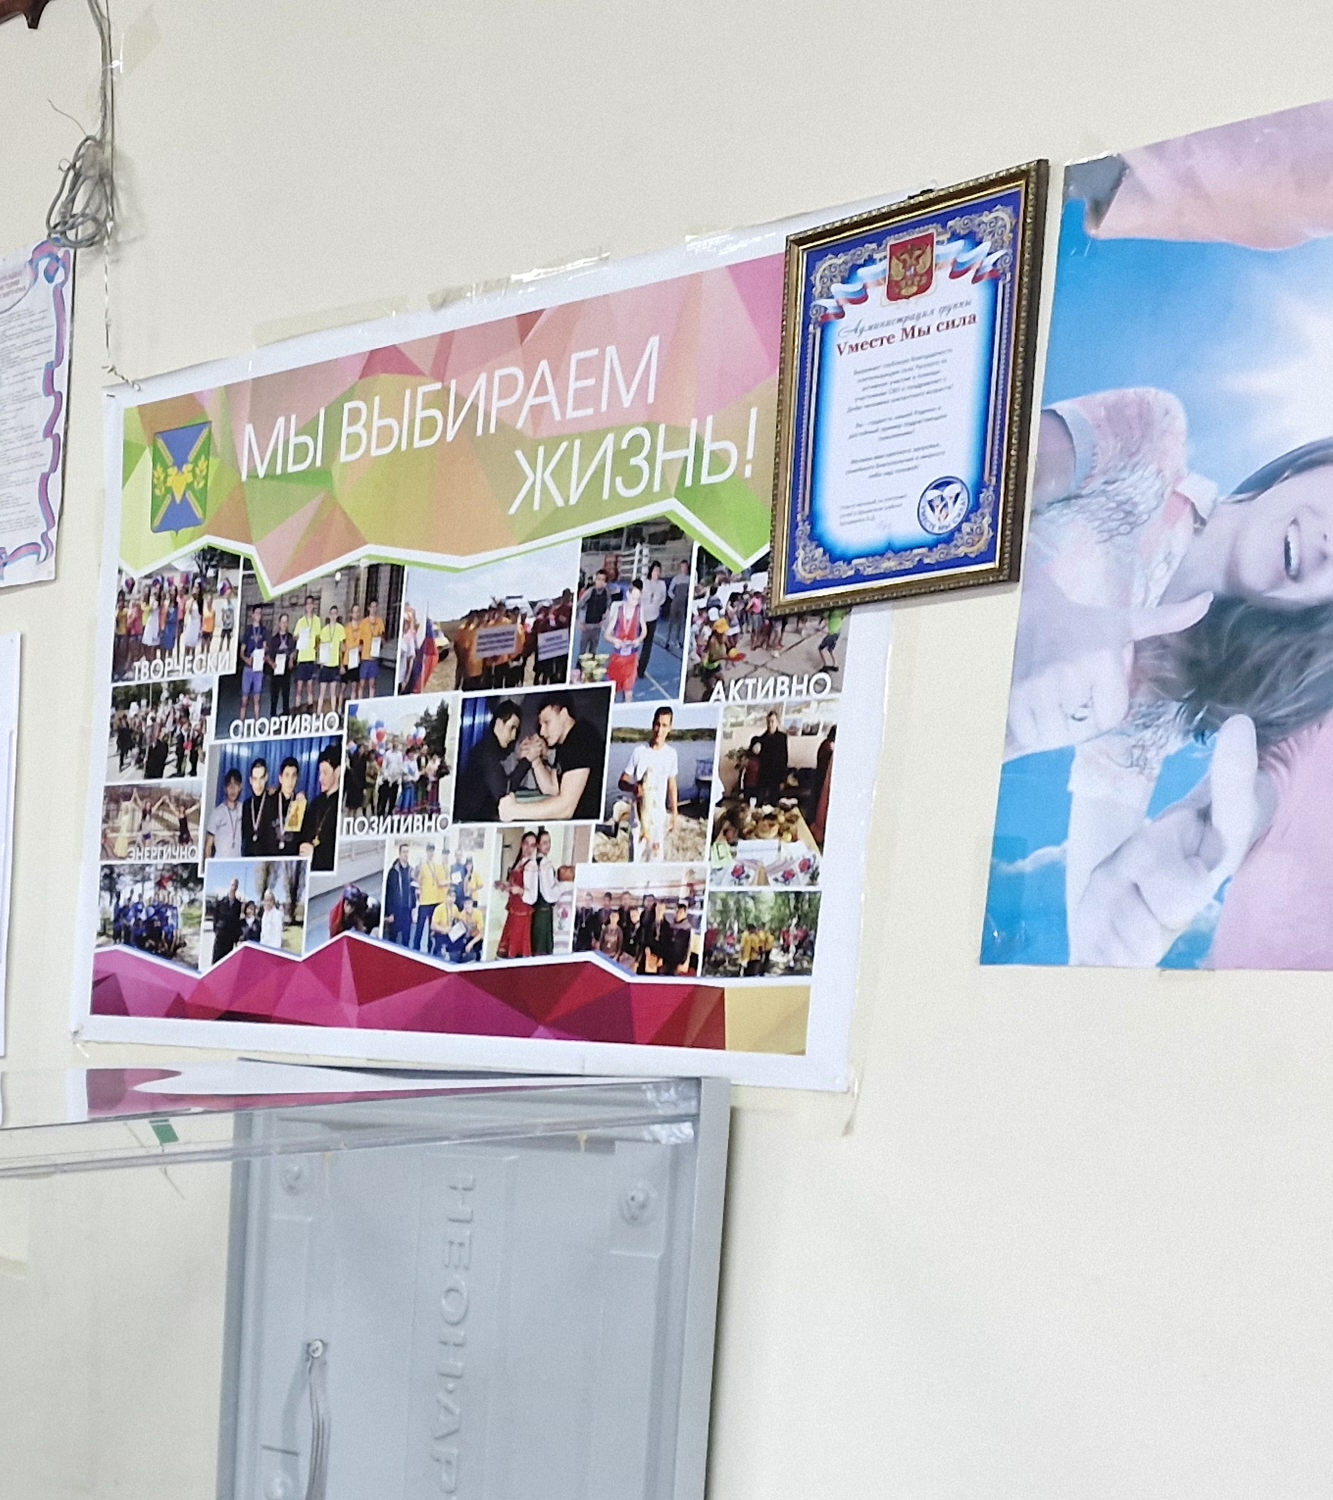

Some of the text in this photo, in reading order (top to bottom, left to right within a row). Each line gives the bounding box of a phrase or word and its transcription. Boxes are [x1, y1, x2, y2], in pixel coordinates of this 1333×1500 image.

[900, 324, 931, 342] Мы
[936, 313, 977, 333] сила
[240, 335, 660, 482] МЫ ВЫБИРАЕМ
[508, 407, 758, 516] ЖИЗНЬ!
[134, 651, 230, 681] ТВОРЧЕСКИ
[709, 672, 832, 702] АКТИВНО
[229, 711, 340, 739] СПОРТИВНО
[342, 814, 450, 835] ПОЗИТИВНО
[127, 845, 198, 860] ЭНЕРГИЧНО
